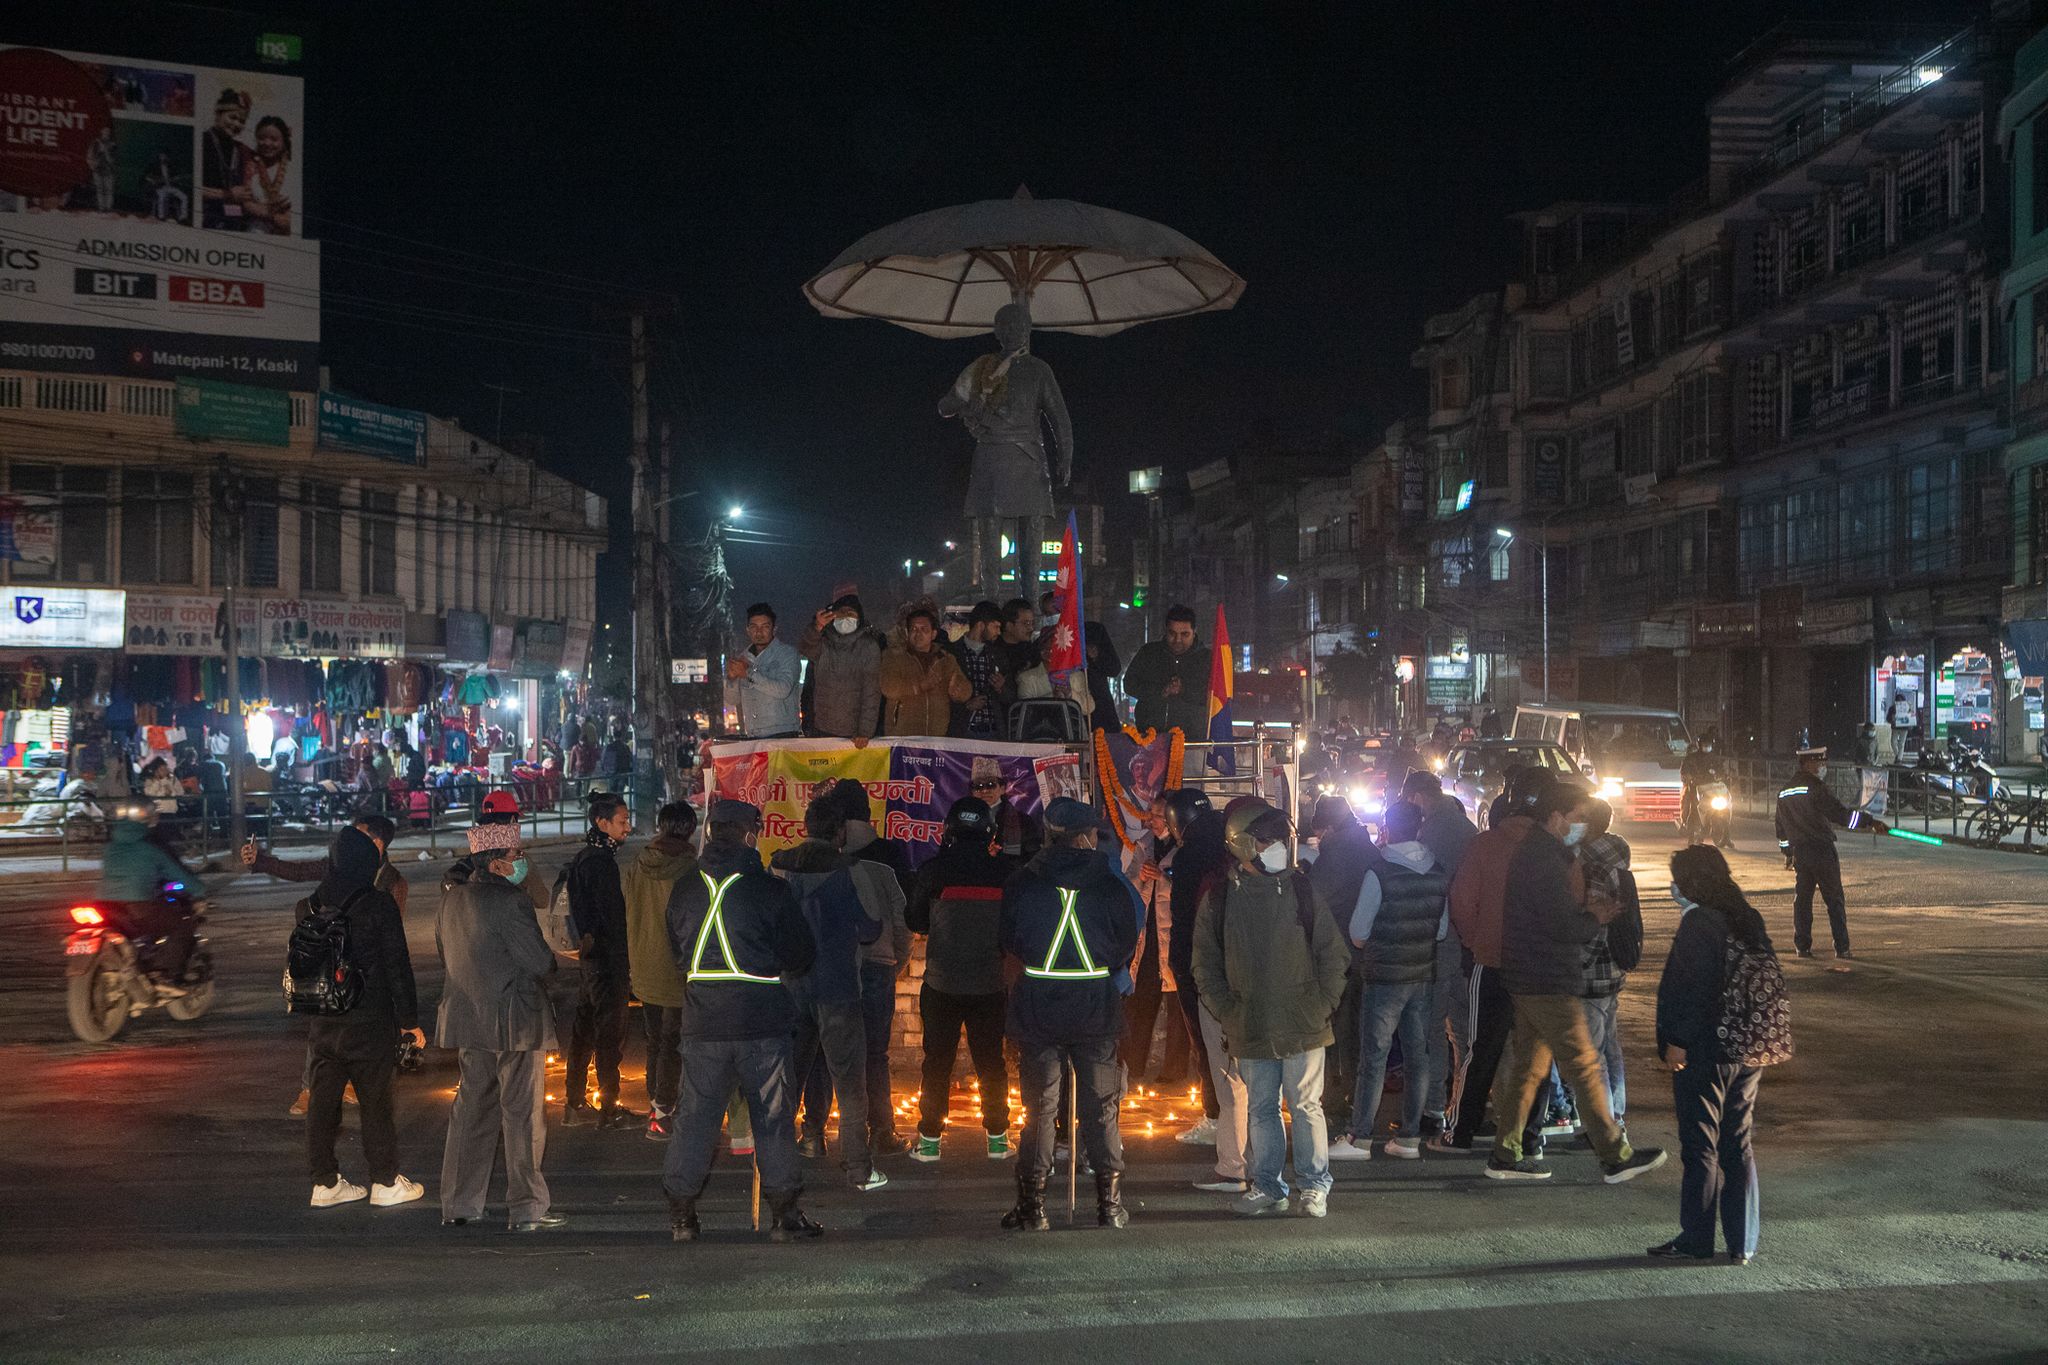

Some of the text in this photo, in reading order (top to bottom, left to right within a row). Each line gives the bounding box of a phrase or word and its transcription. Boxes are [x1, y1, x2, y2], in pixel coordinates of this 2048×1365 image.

[0, 93, 78, 110] IBRANT
[6, 126, 59, 147] LIFE
[77, 239, 265, 270] ADMISSION OPEN
[93, 273, 247, 305] BIT BBA
[256, 358, 298, 373] Kaski
[20, 599, 40, 618] K
[264, 603, 308, 619] SALE
[862, 775, 935, 806] यन्ती
